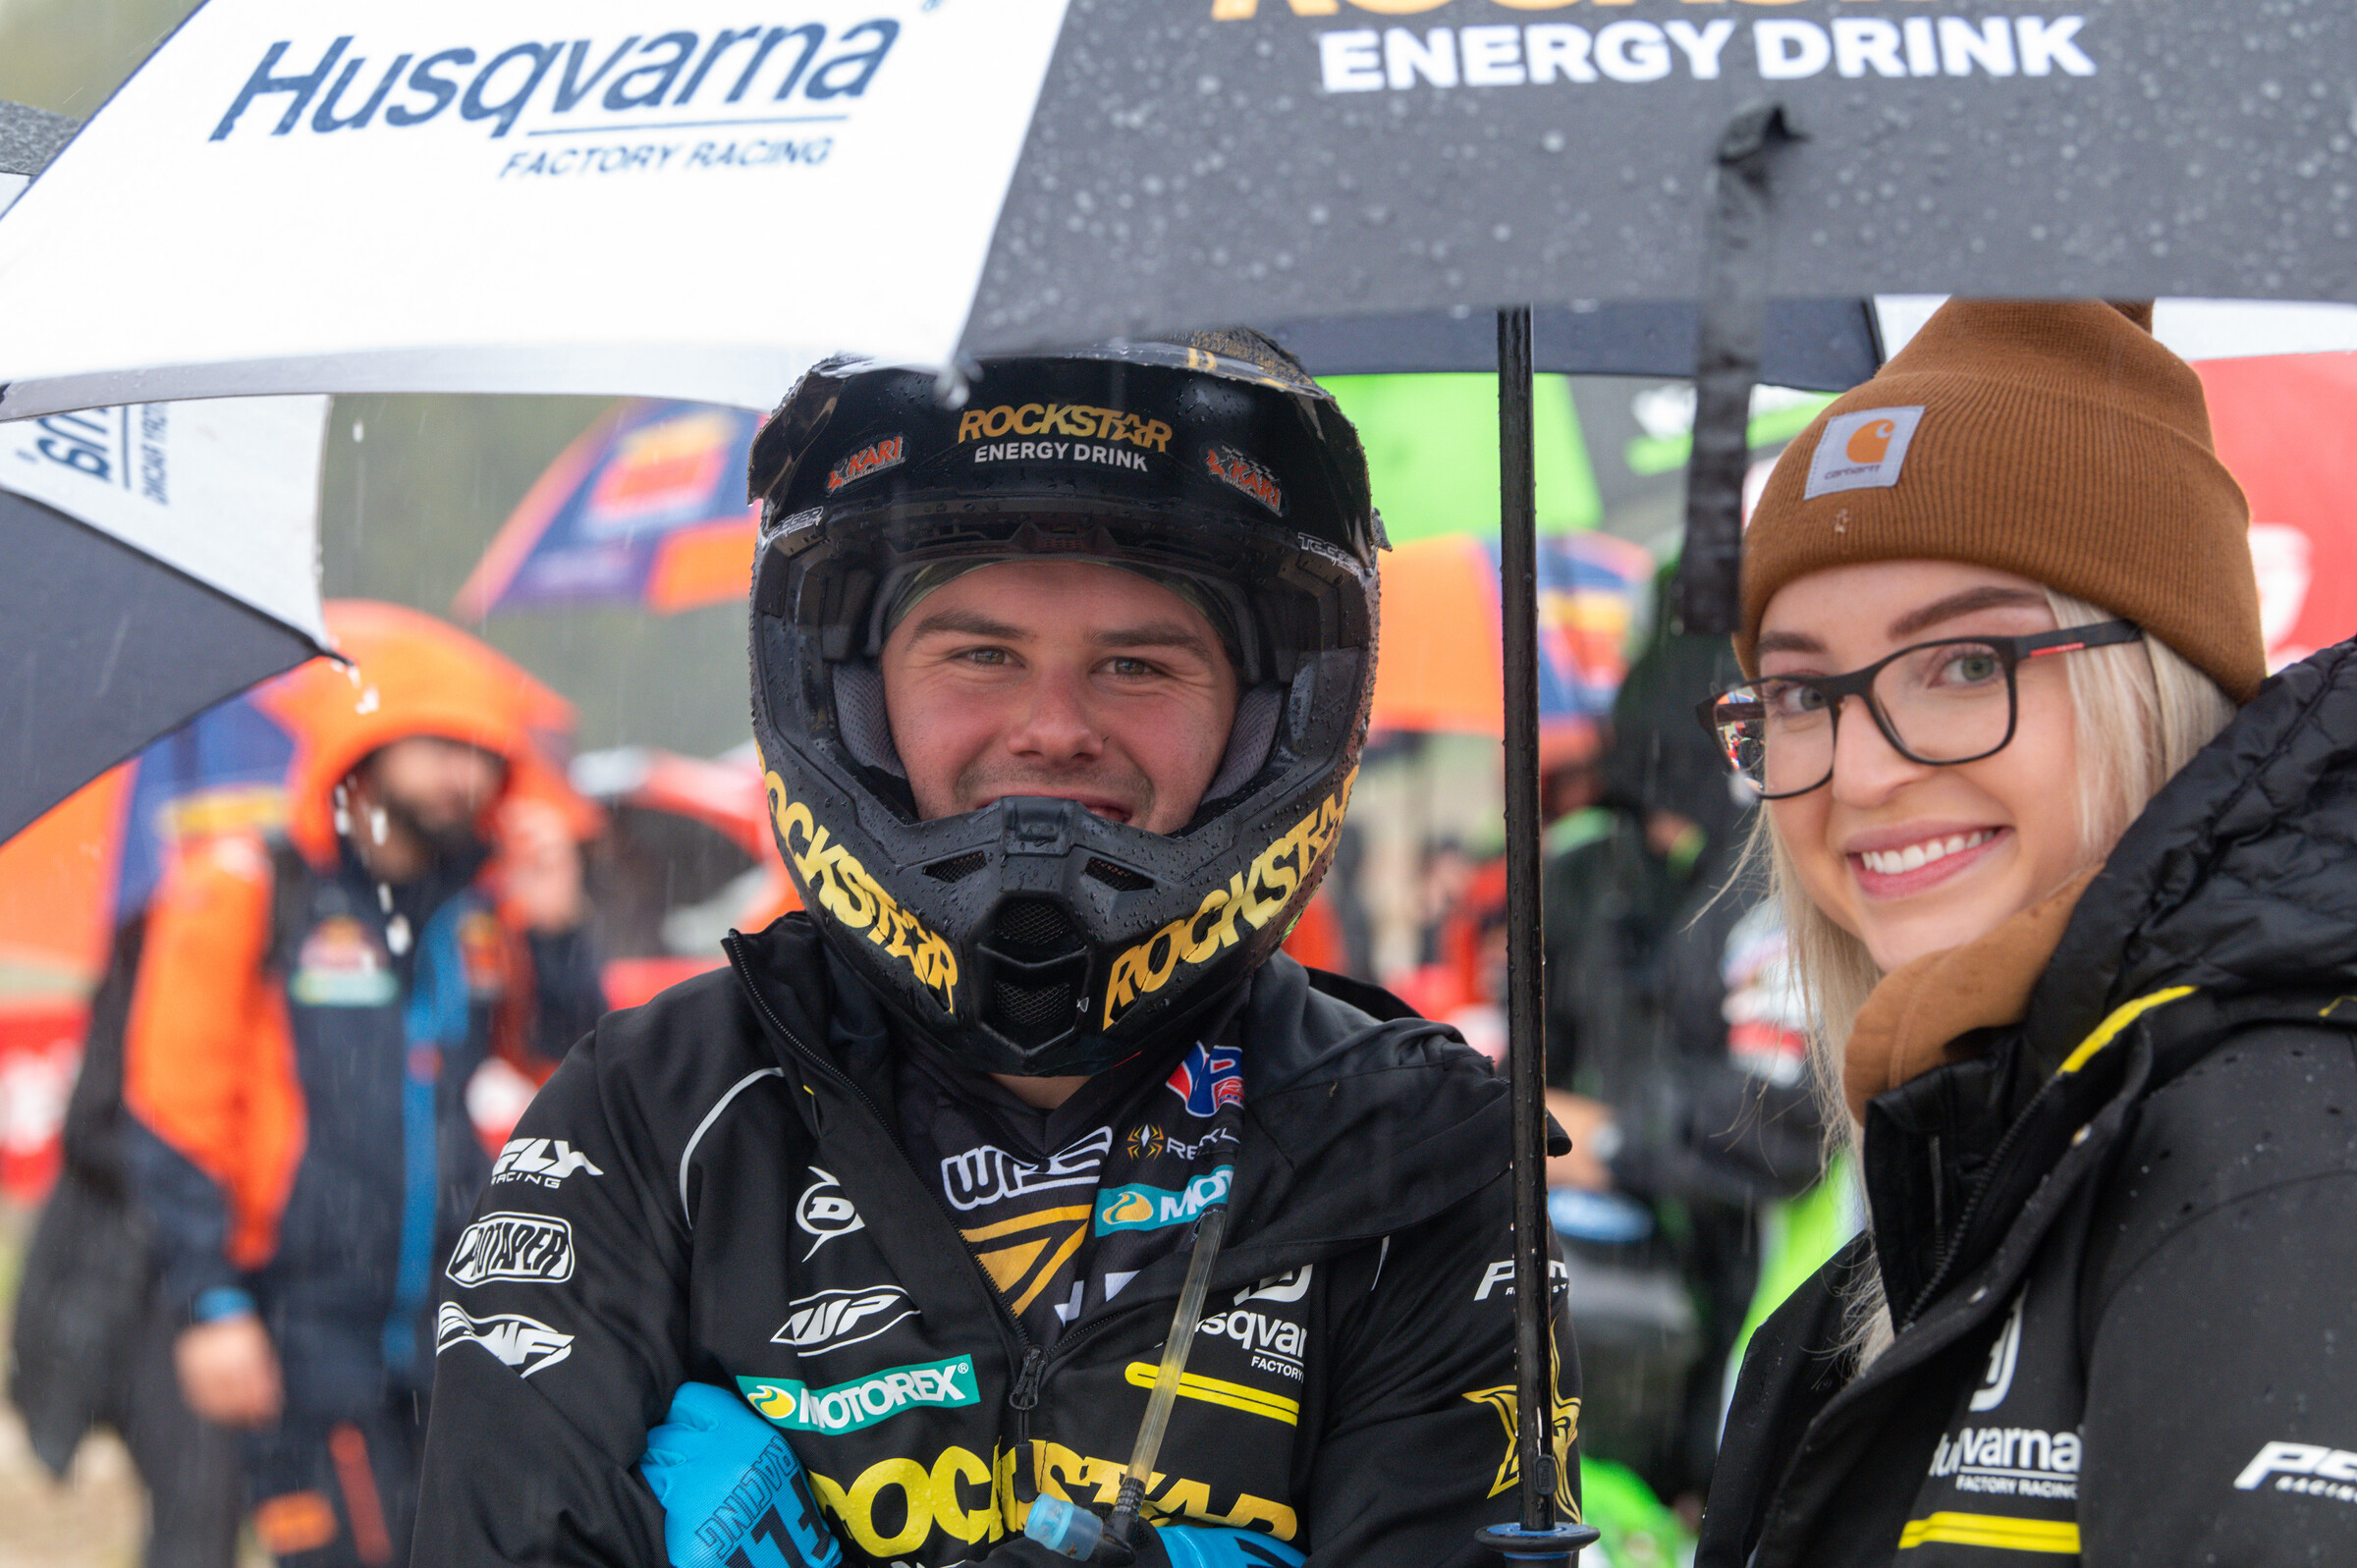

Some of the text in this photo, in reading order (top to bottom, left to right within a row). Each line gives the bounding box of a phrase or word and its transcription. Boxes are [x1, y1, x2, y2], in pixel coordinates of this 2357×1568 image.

[208, 19, 900, 141] Husqvarna
[1319, 16, 2097, 93] ENERGY DRINK
[498, 137, 834, 178] FACTORY RACING
[959, 404, 1173, 453] ROCKSTAR
[974, 442, 1148, 472] ENERGY DRINK
[754, 736, 959, 1014] OCKSTAR
[1103, 765, 1359, 1031] ROCKSTA
[799, 1365, 966, 1430] MOTOREX
